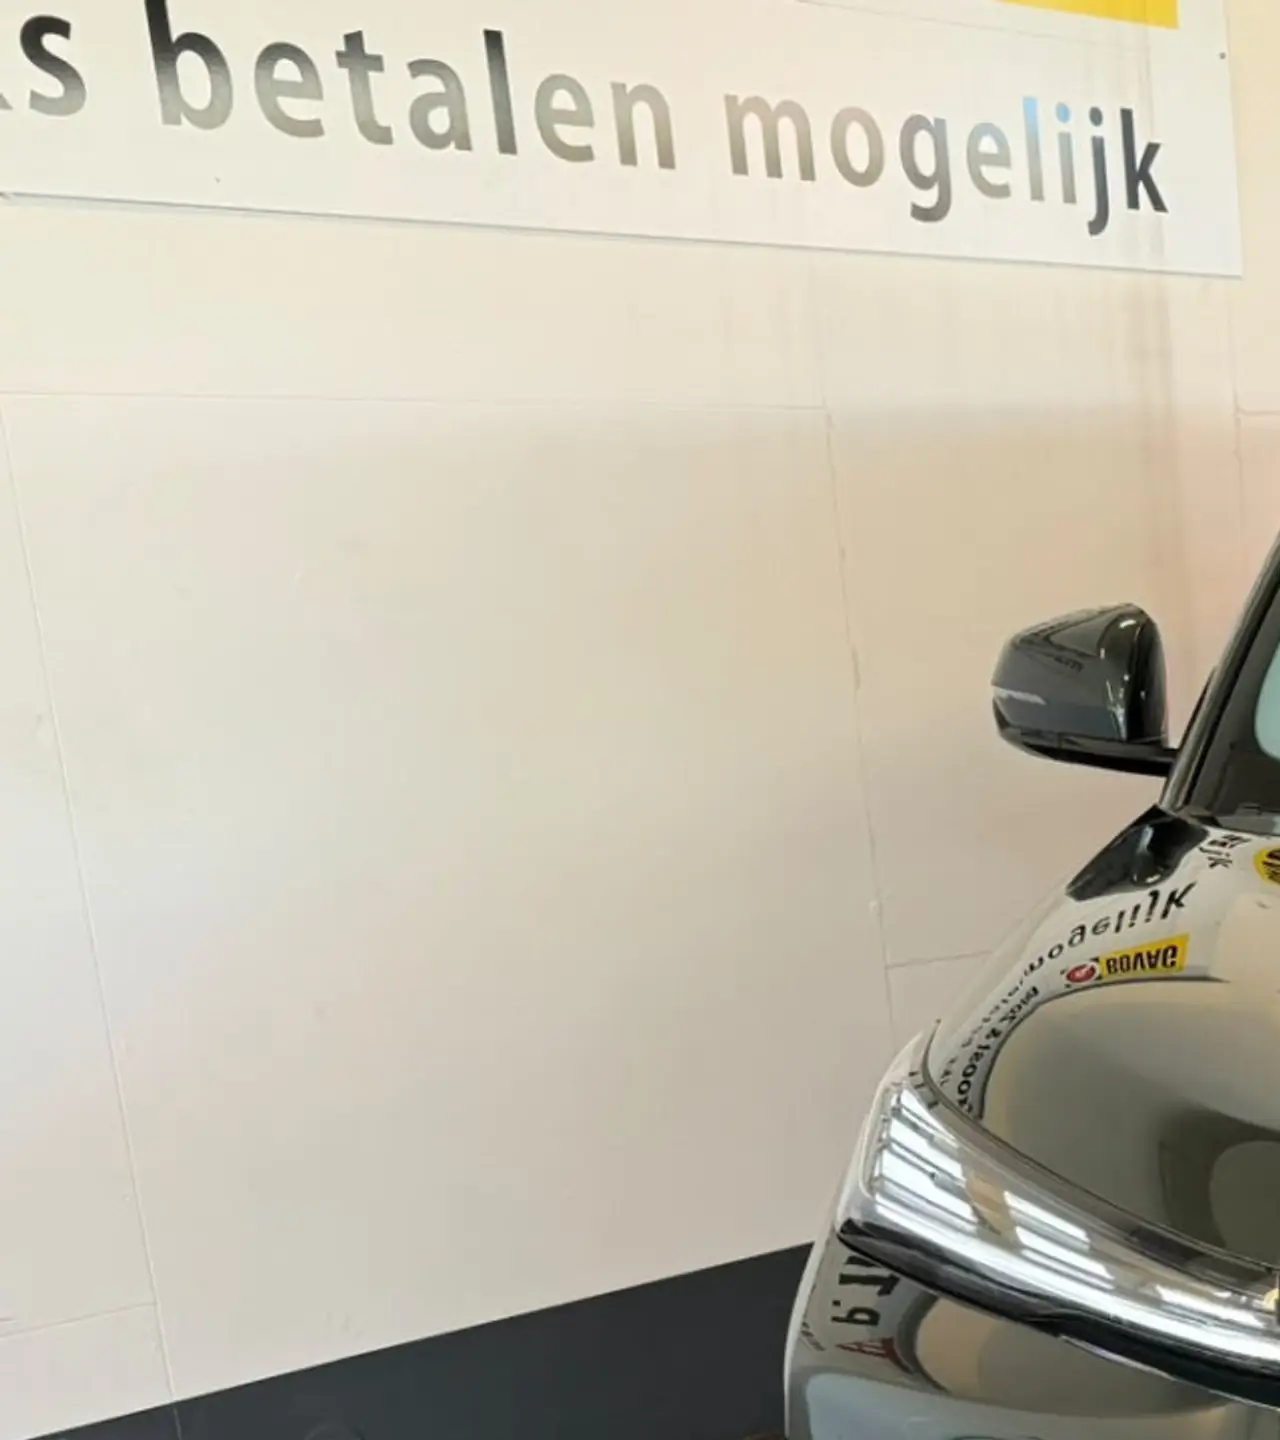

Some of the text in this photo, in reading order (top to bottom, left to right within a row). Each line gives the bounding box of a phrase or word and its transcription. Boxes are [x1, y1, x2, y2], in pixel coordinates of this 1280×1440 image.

[0, 0, 1169, 236] s betalen mogelijk
